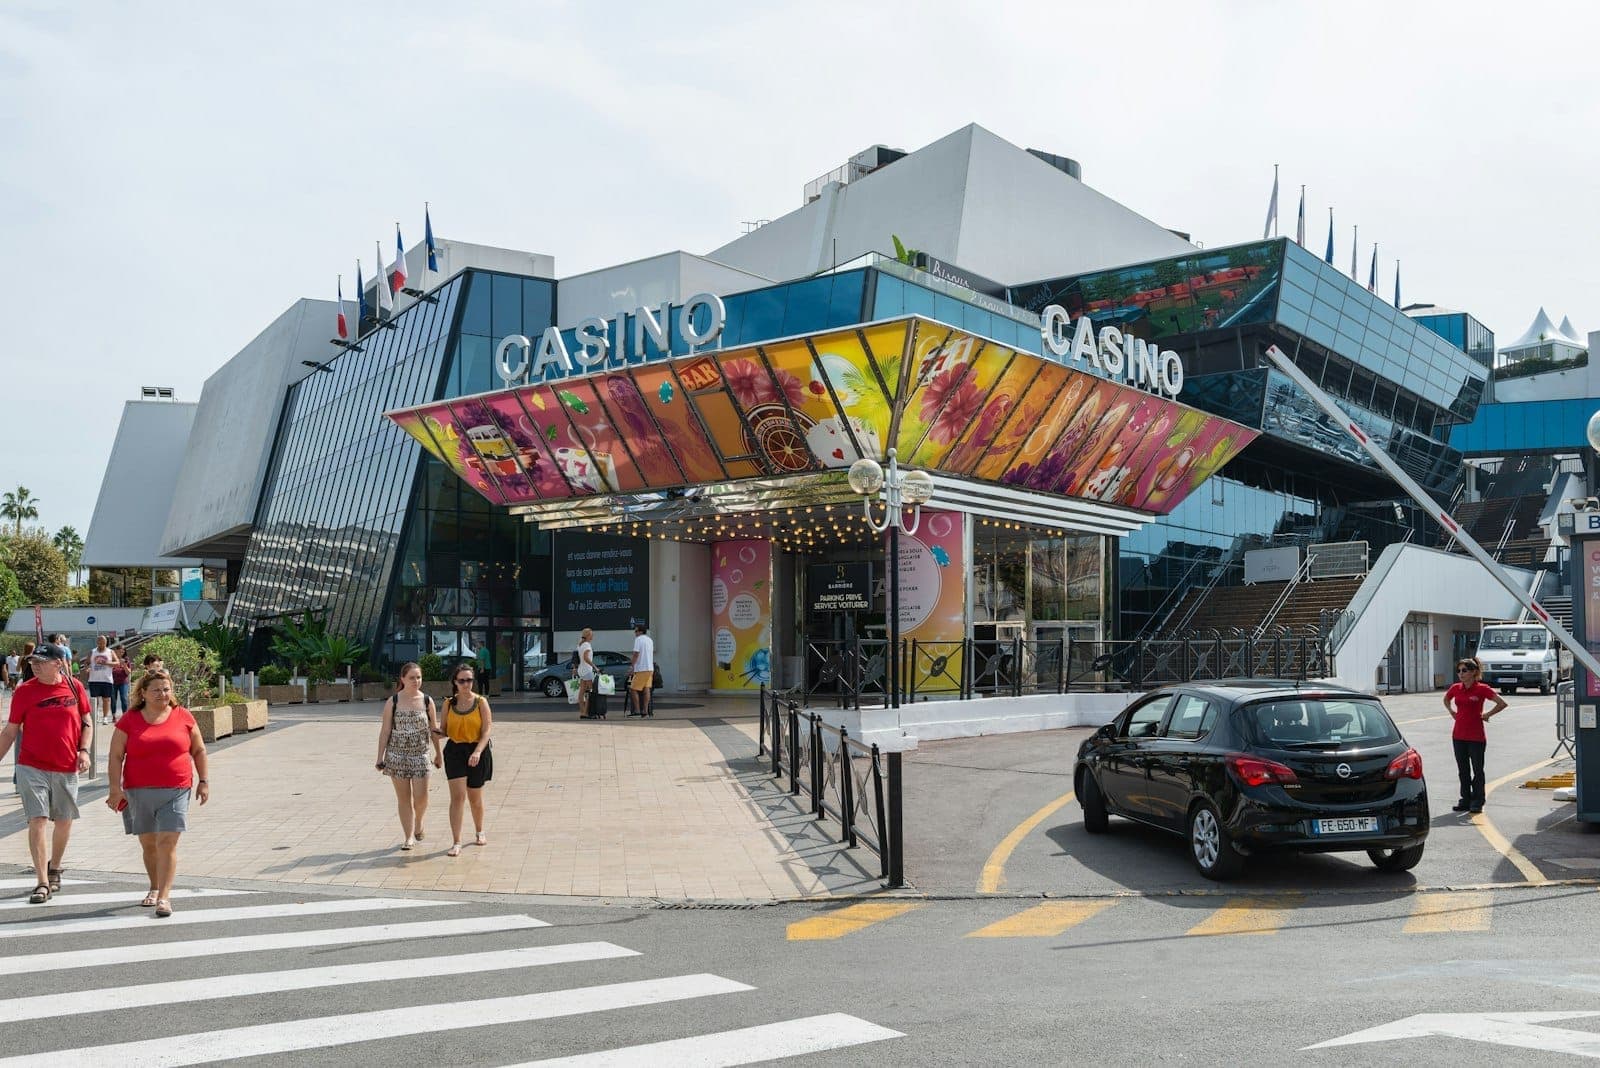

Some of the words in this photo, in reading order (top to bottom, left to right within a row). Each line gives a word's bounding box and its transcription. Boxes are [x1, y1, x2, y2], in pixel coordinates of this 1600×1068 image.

[495, 292, 727, 383] CASINO
[1041, 304, 1184, 396] CASINO
[679, 362, 720, 392] BAR
[608, 578, 629, 592] Paris
[586, 600, 592, 610] 15
[618, 599, 631, 609] 2019
[820, 594, 845, 602] PARKING
[838, 601, 869, 609] VOITURIER
